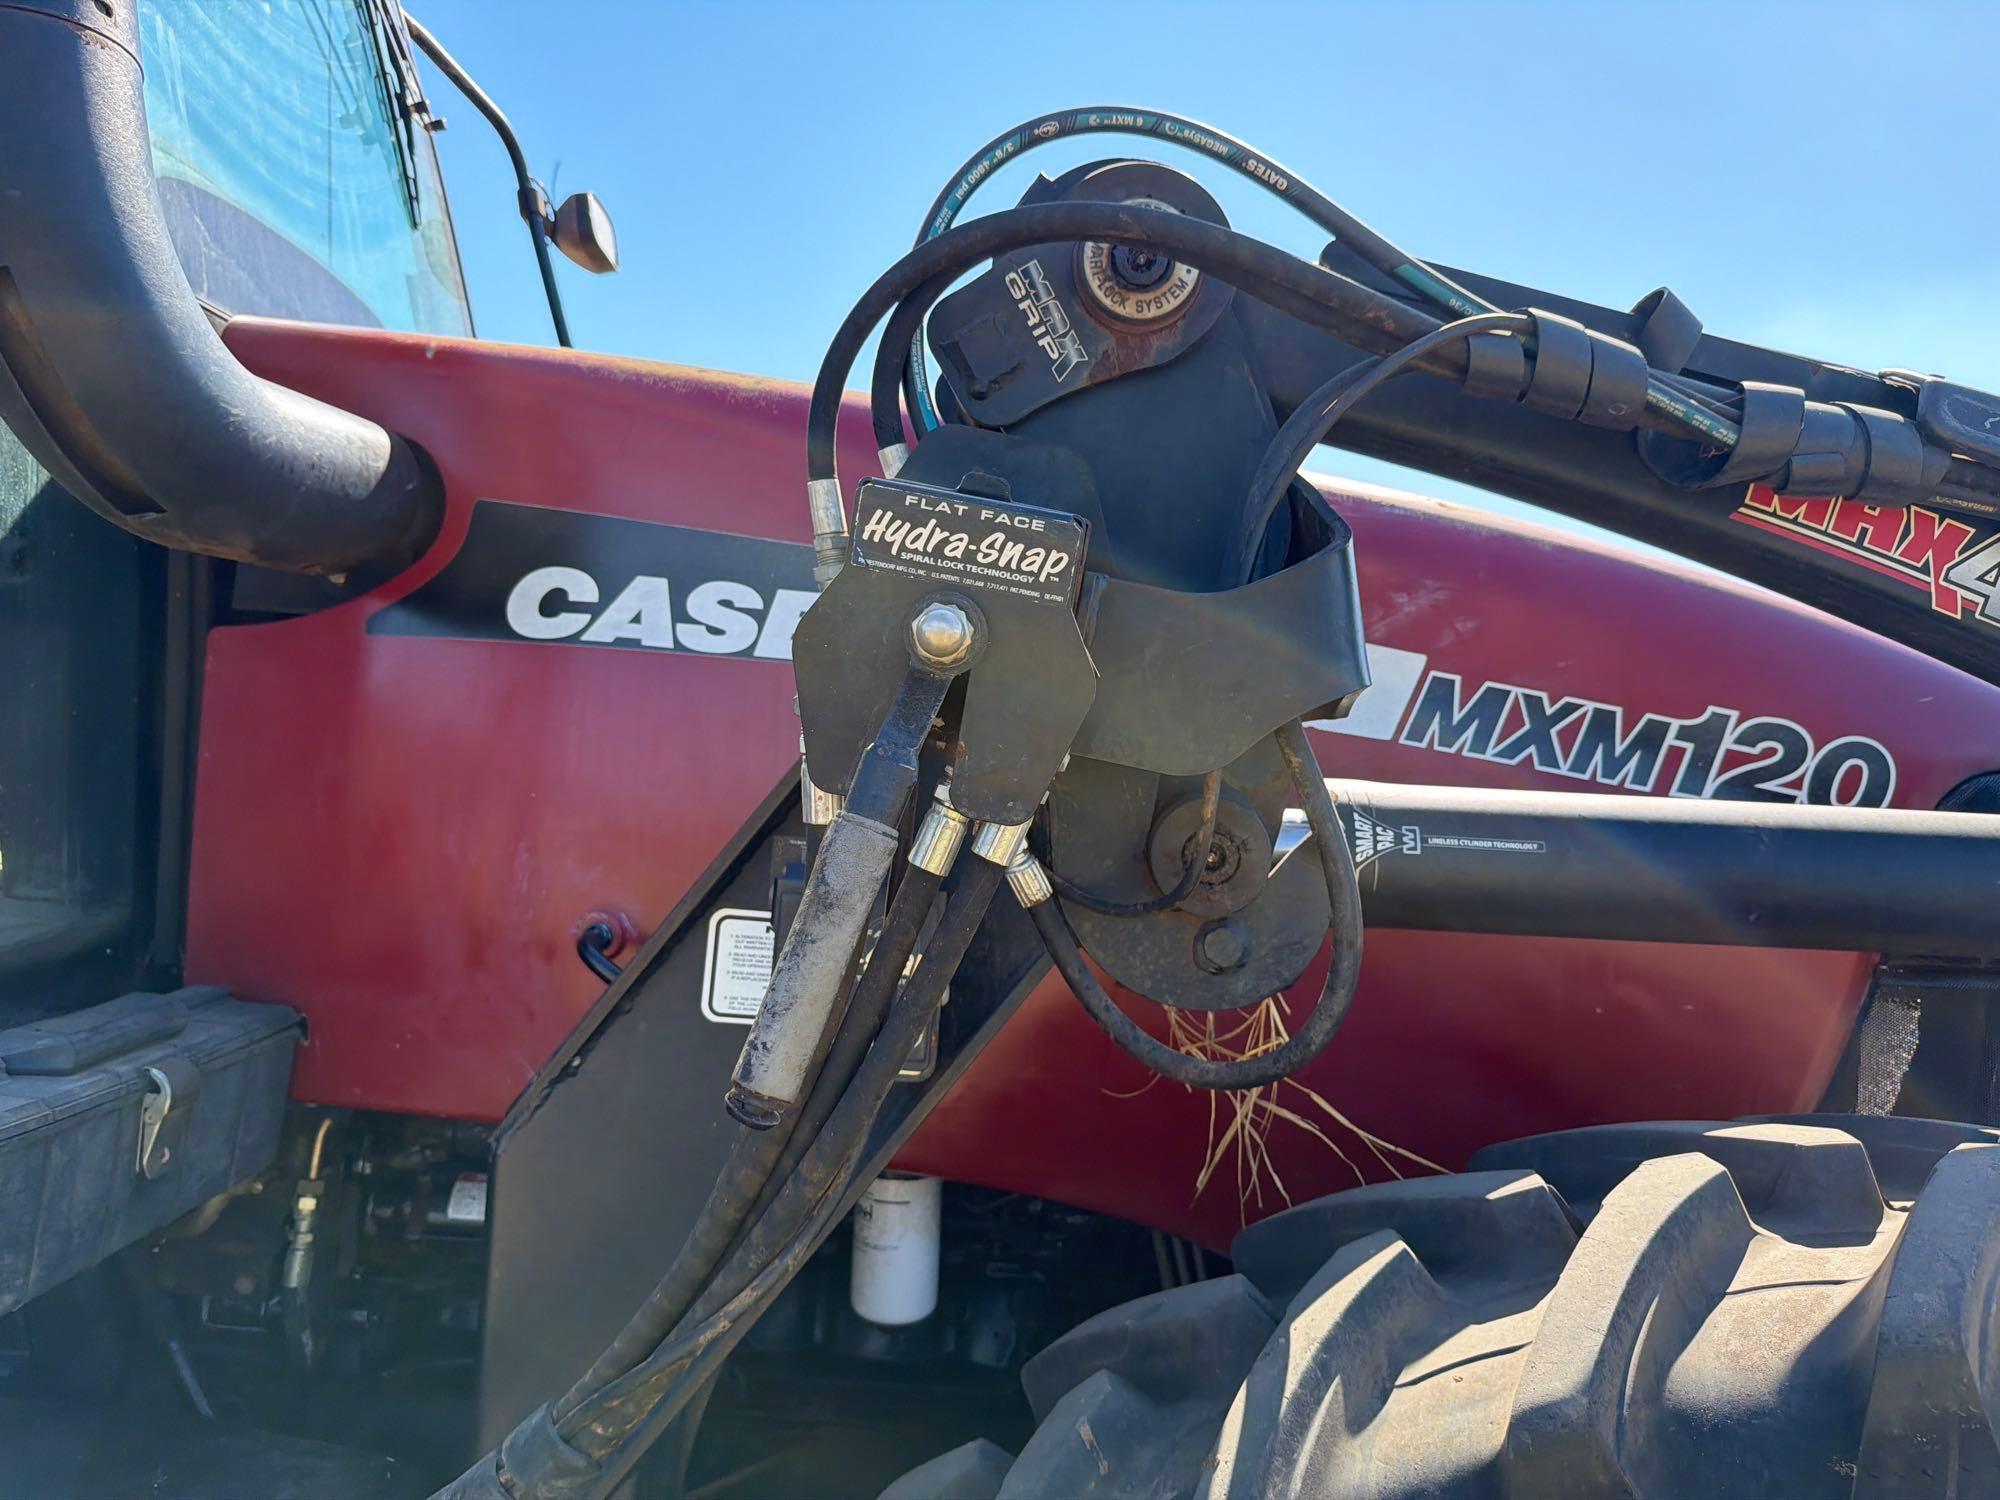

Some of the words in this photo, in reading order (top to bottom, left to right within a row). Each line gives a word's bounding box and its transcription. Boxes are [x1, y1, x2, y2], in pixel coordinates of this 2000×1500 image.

[967, 158, 992, 185] 4800
[1246, 157, 1289, 192] GATES
[1135, 277, 1190, 314] SYSTEM
[1004, 271, 1064, 361] GRIP
[1018, 259, 1089, 383] MAX
[905, 495, 969, 517] FLAT
[980, 510, 1046, 532] FACE
[862, 508, 1069, 583] Hydra-Snap
[1744, 483, 1977, 620] MAX
[900, 551, 936, 567] SPIRAL
[937, 557, 965, 571] LOCK
[965, 563, 1035, 584] TECHNOLOGY
[1399, 670, 1897, 808] MXM120
[1353, 812, 1374, 864] SMART
[1376, 826, 1395, 851] PAC
[1459, 839, 1493, 848] CYLINDER
[1493, 841, 1538, 850] TECHNOLOGY
